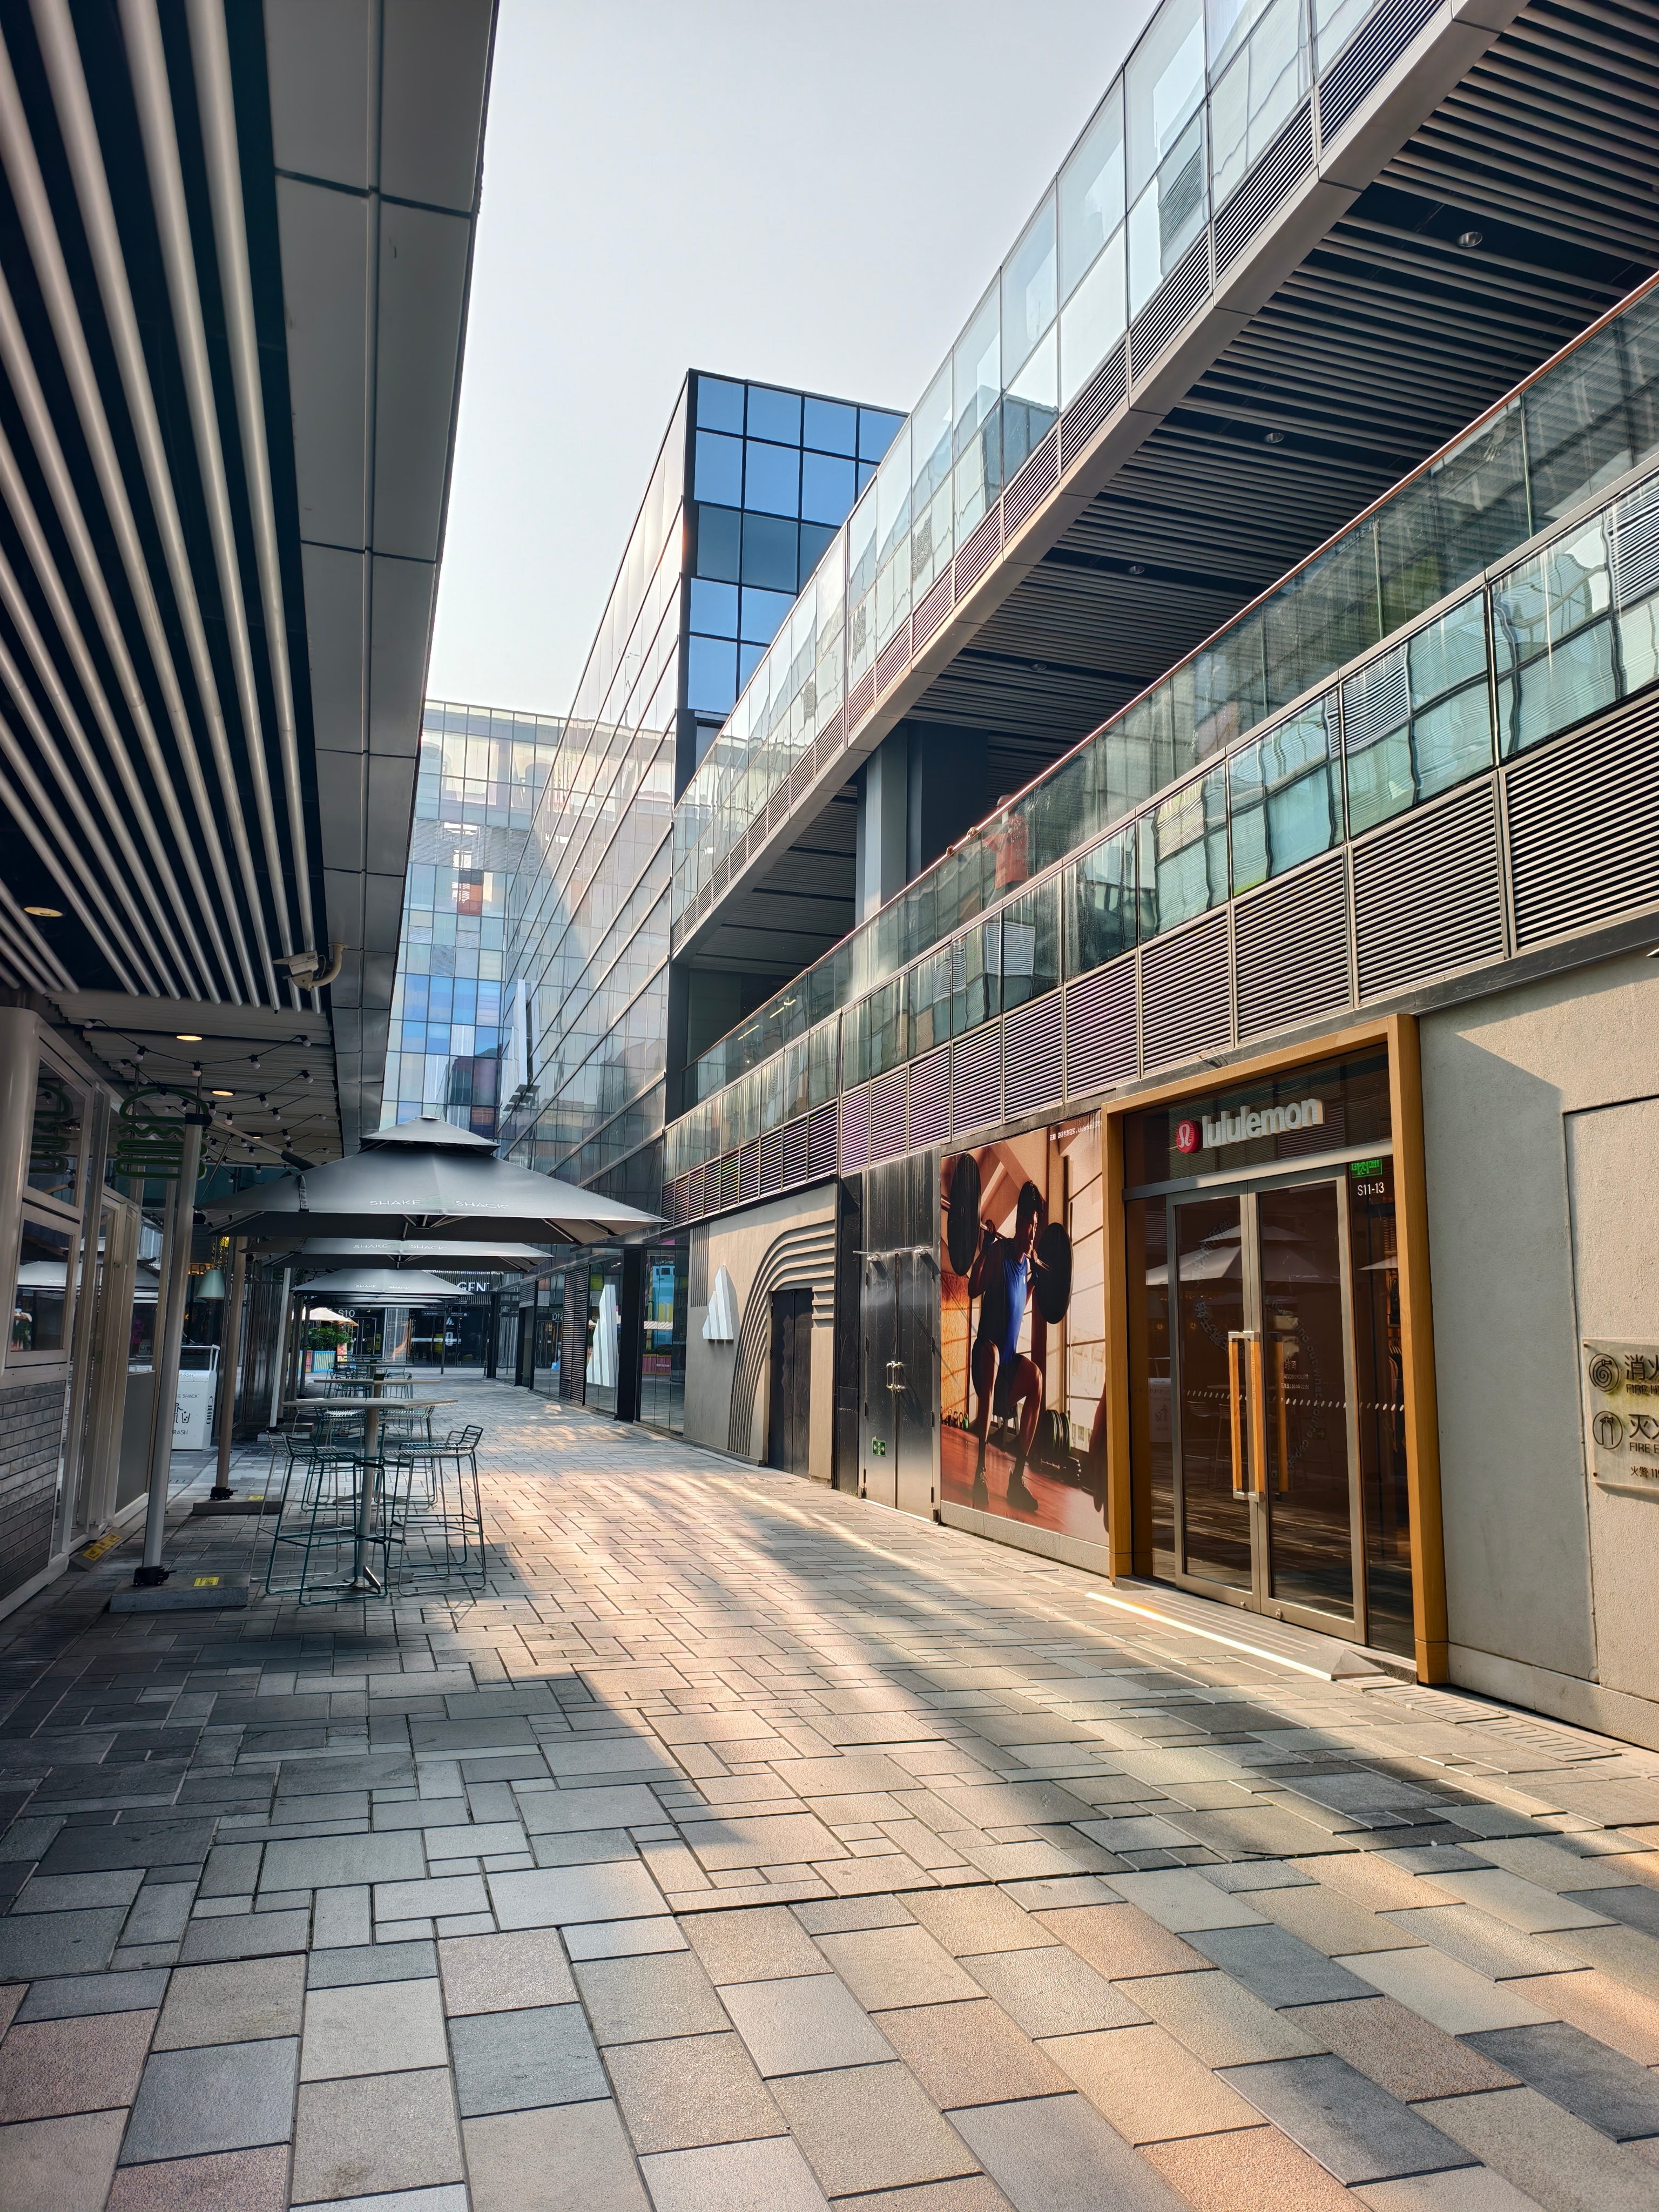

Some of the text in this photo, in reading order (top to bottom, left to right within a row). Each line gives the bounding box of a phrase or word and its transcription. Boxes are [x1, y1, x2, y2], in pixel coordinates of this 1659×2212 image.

[1202, 1098, 1324, 1148] lululemon
[1357, 1182, 1385, 1196] S11-13
[456, 1201, 506, 1209] SHACK
[338, 1309, 355, 1318] S10
[1626, 1384, 1648, 1394] FIRE
[1629, 1442, 1651, 1453] FIRE
[1631, 1466, 1659, 1479] 火警 11
